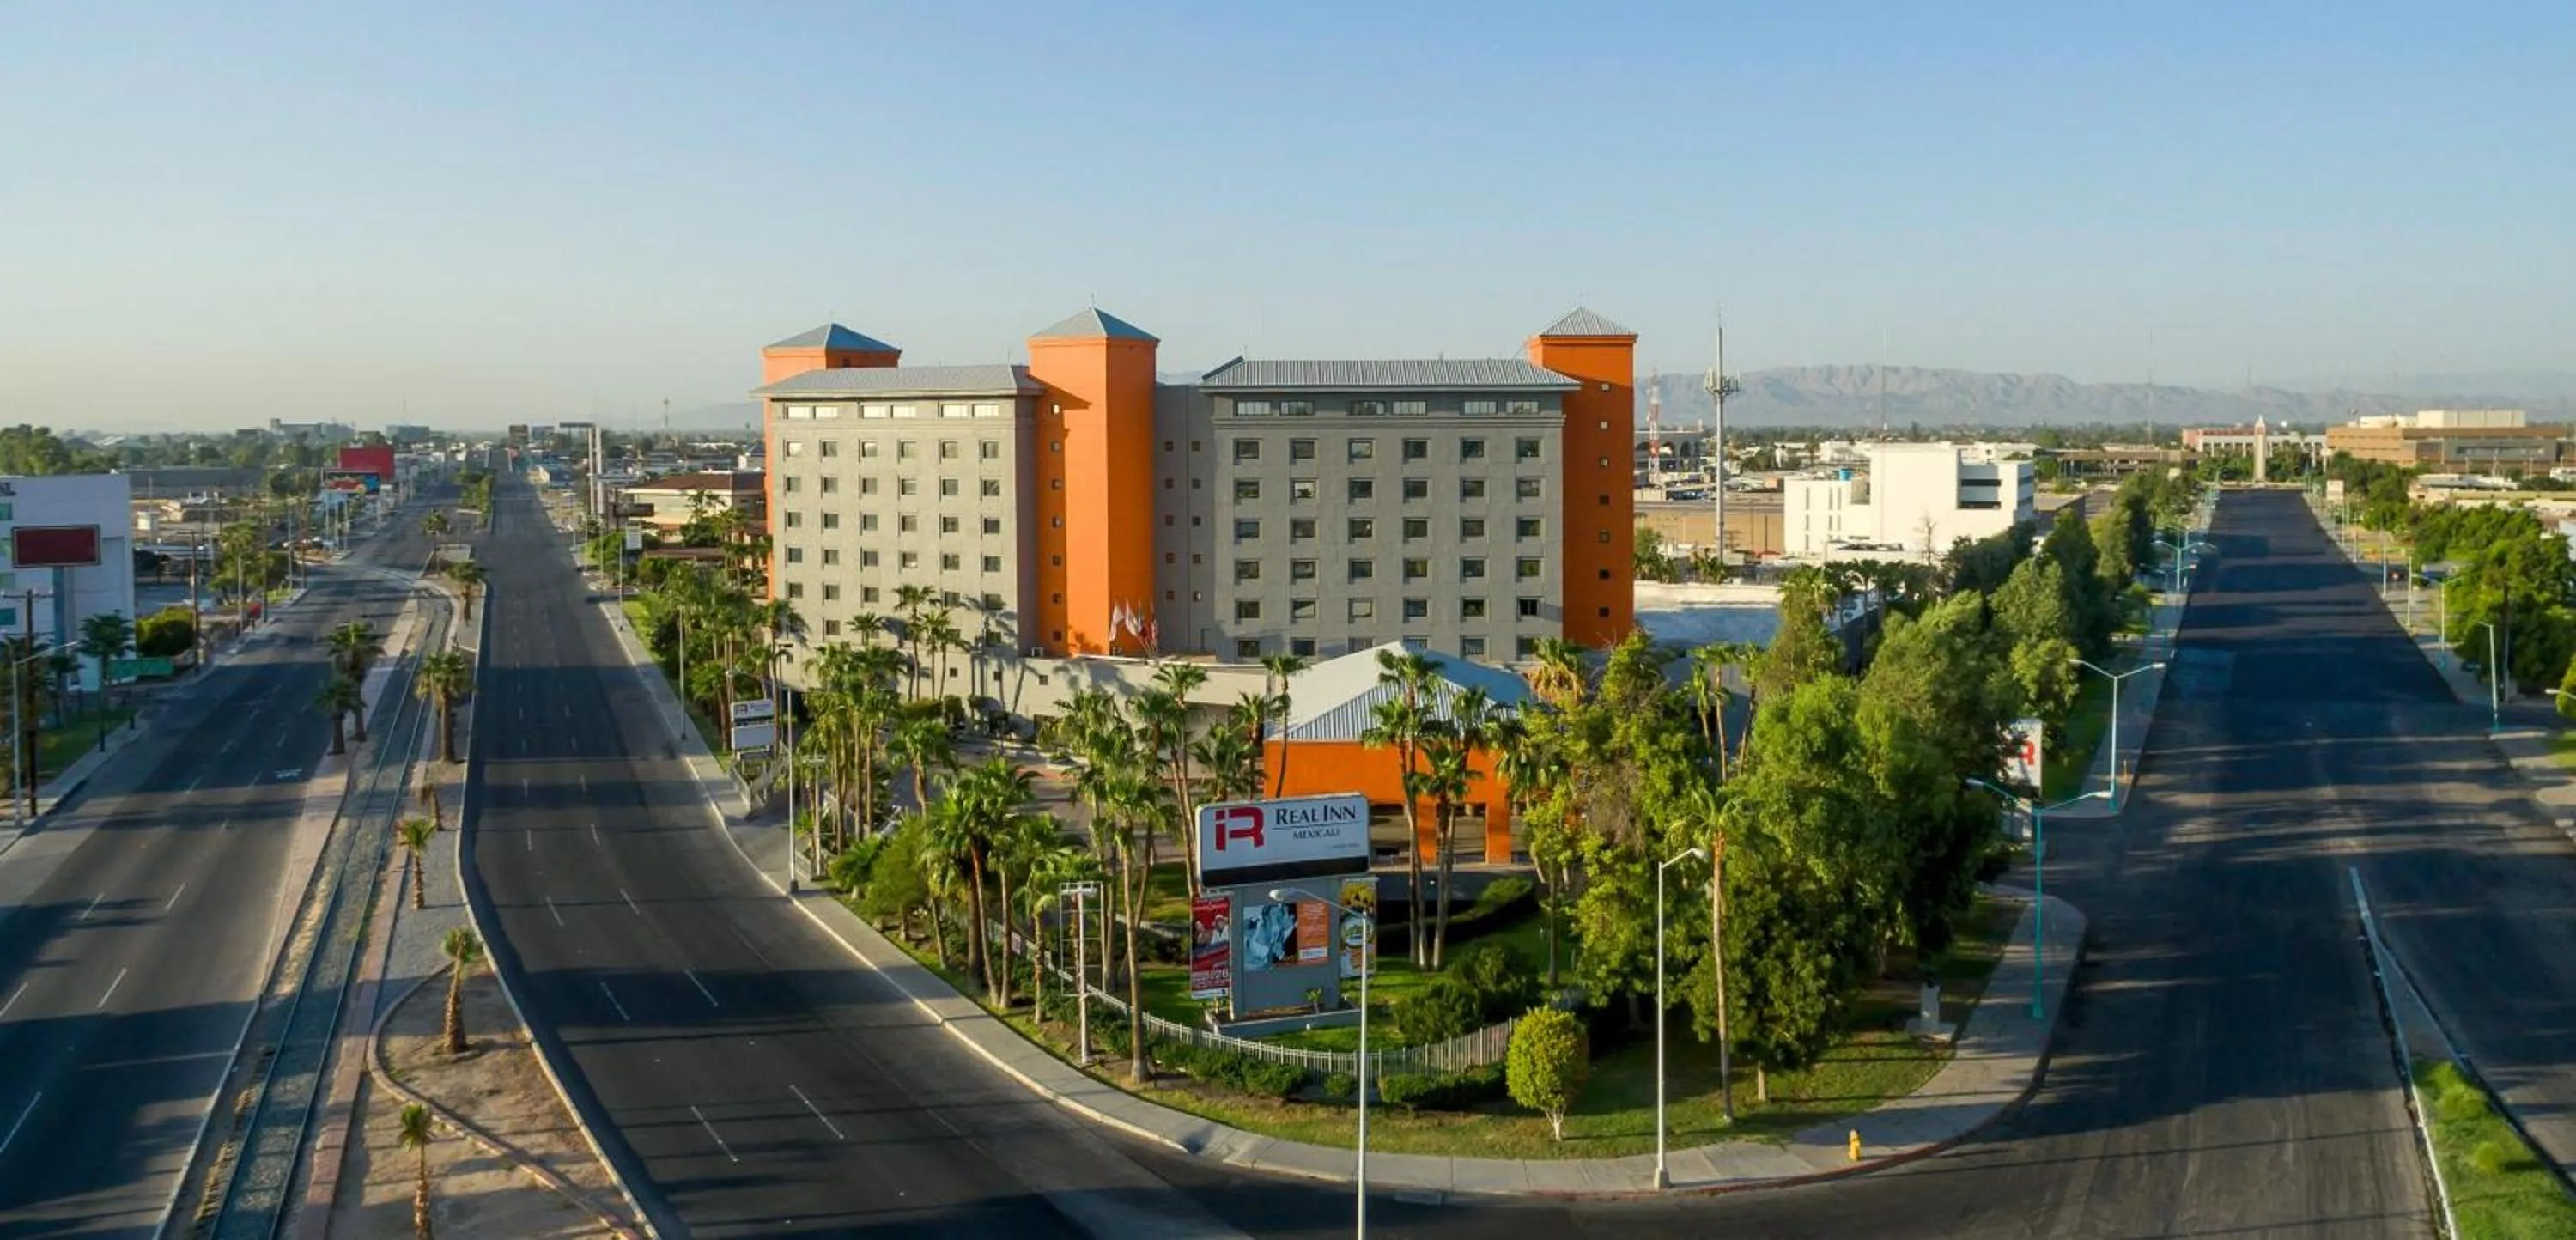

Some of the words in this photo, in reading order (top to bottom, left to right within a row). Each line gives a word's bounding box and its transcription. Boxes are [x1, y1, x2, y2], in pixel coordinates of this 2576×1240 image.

[1275, 807, 1320, 825] REAL
[1323, 804, 1357, 822] INN
[1292, 828, 1340, 840] MEXICALI
